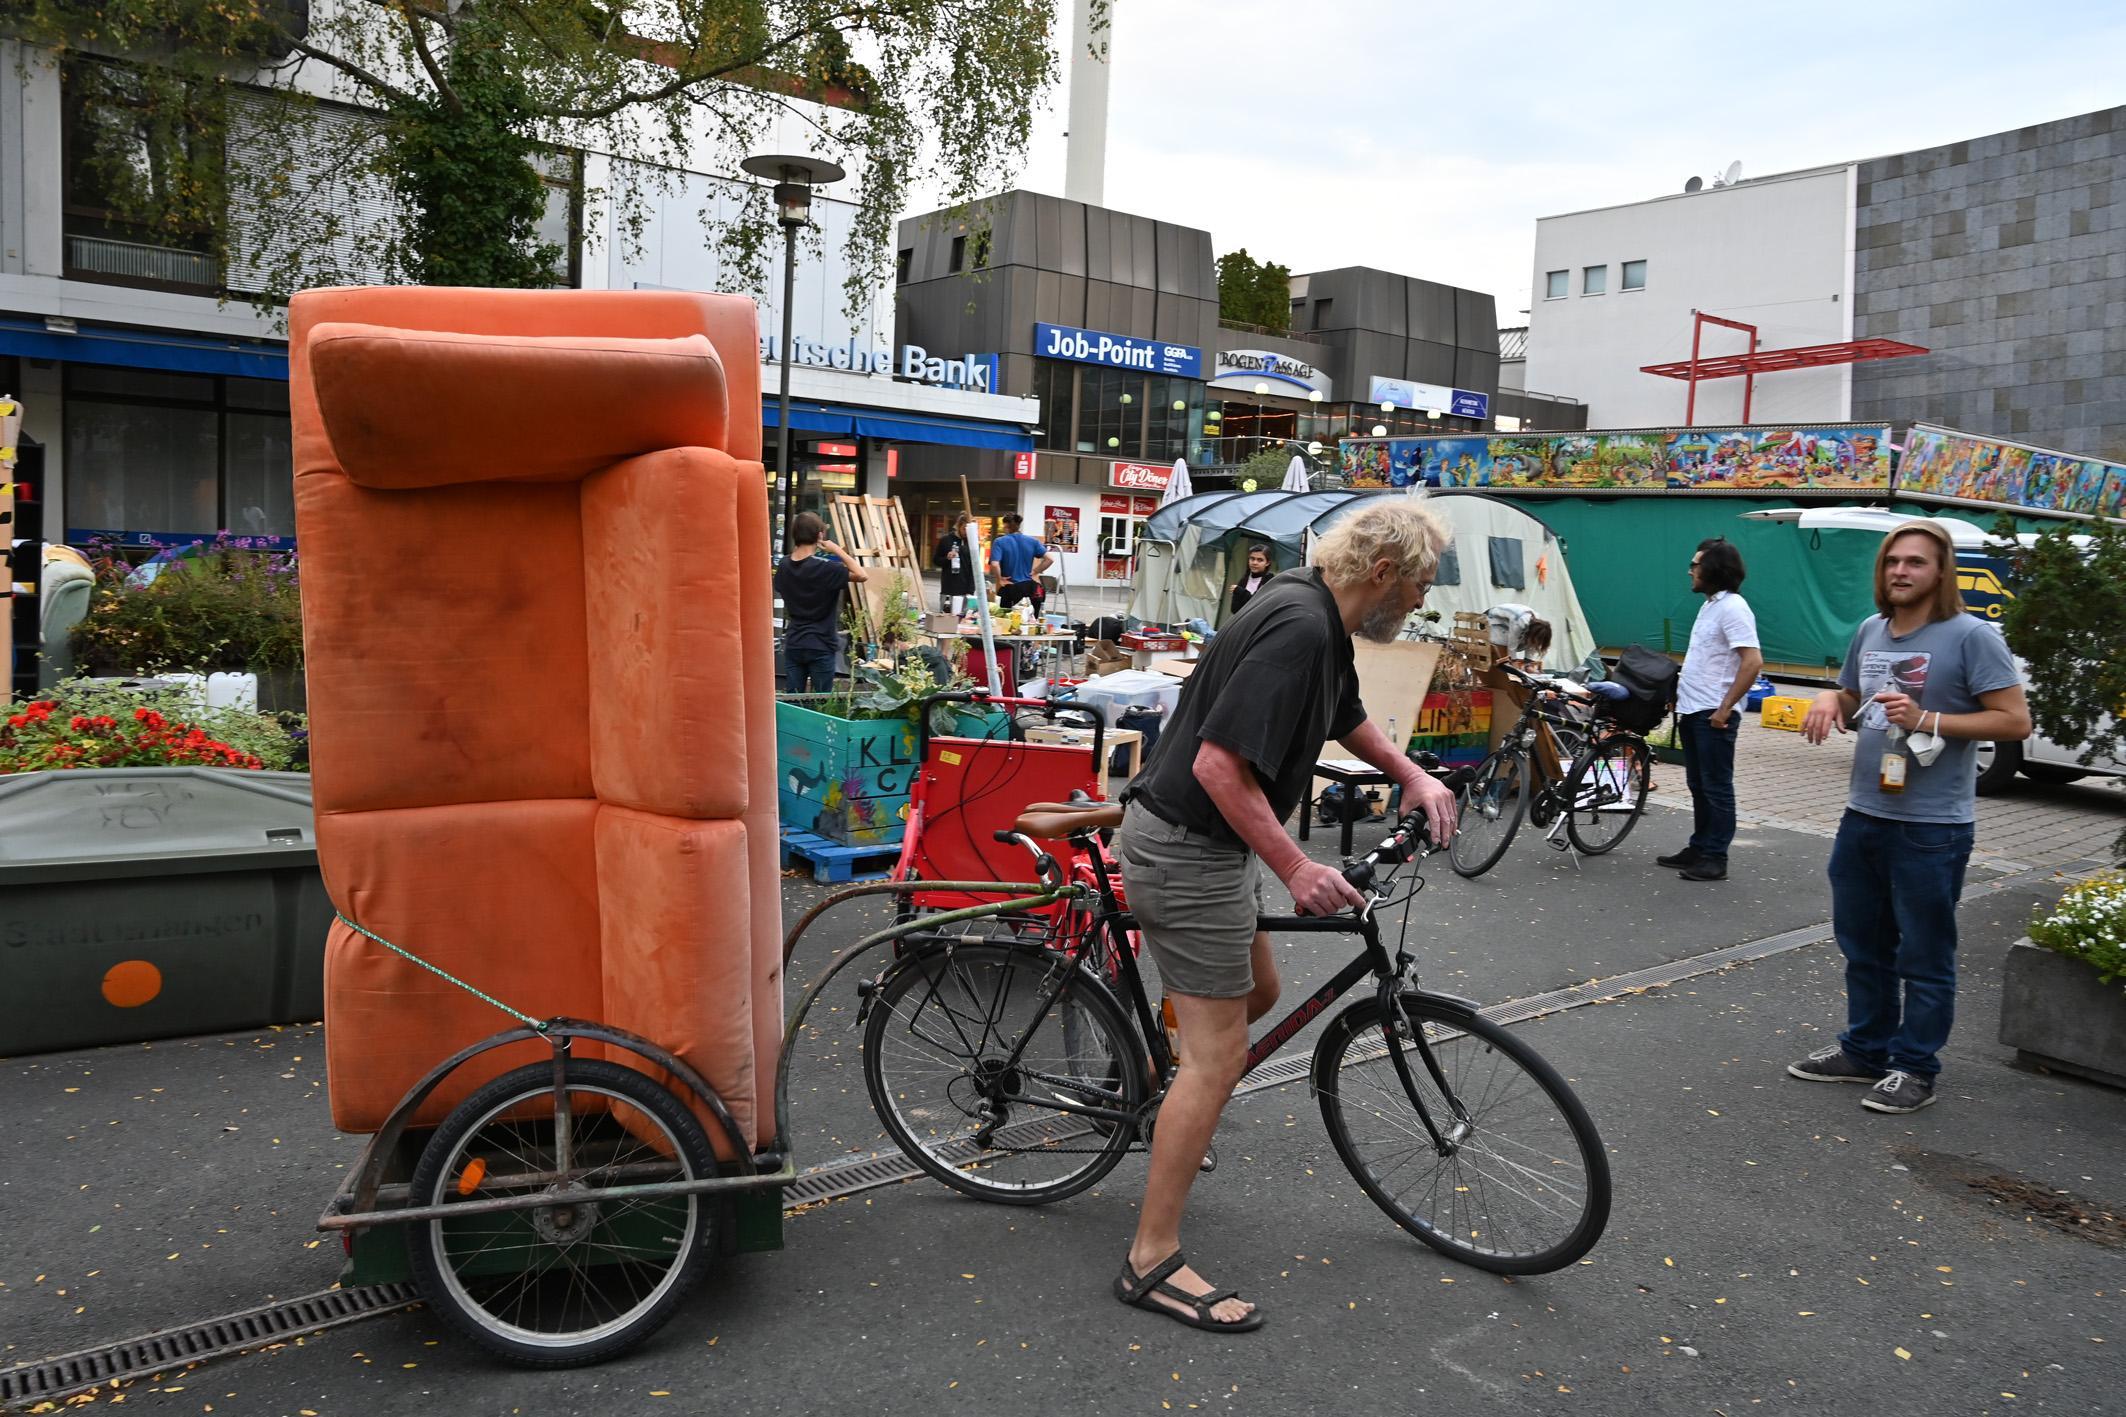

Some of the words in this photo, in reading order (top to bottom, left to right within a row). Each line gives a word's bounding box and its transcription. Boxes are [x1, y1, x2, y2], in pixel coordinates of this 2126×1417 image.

[901, 344, 986, 388] Bank
[1047, 328, 1155, 369] Job-Point
[1119, 467, 1139, 486] City
